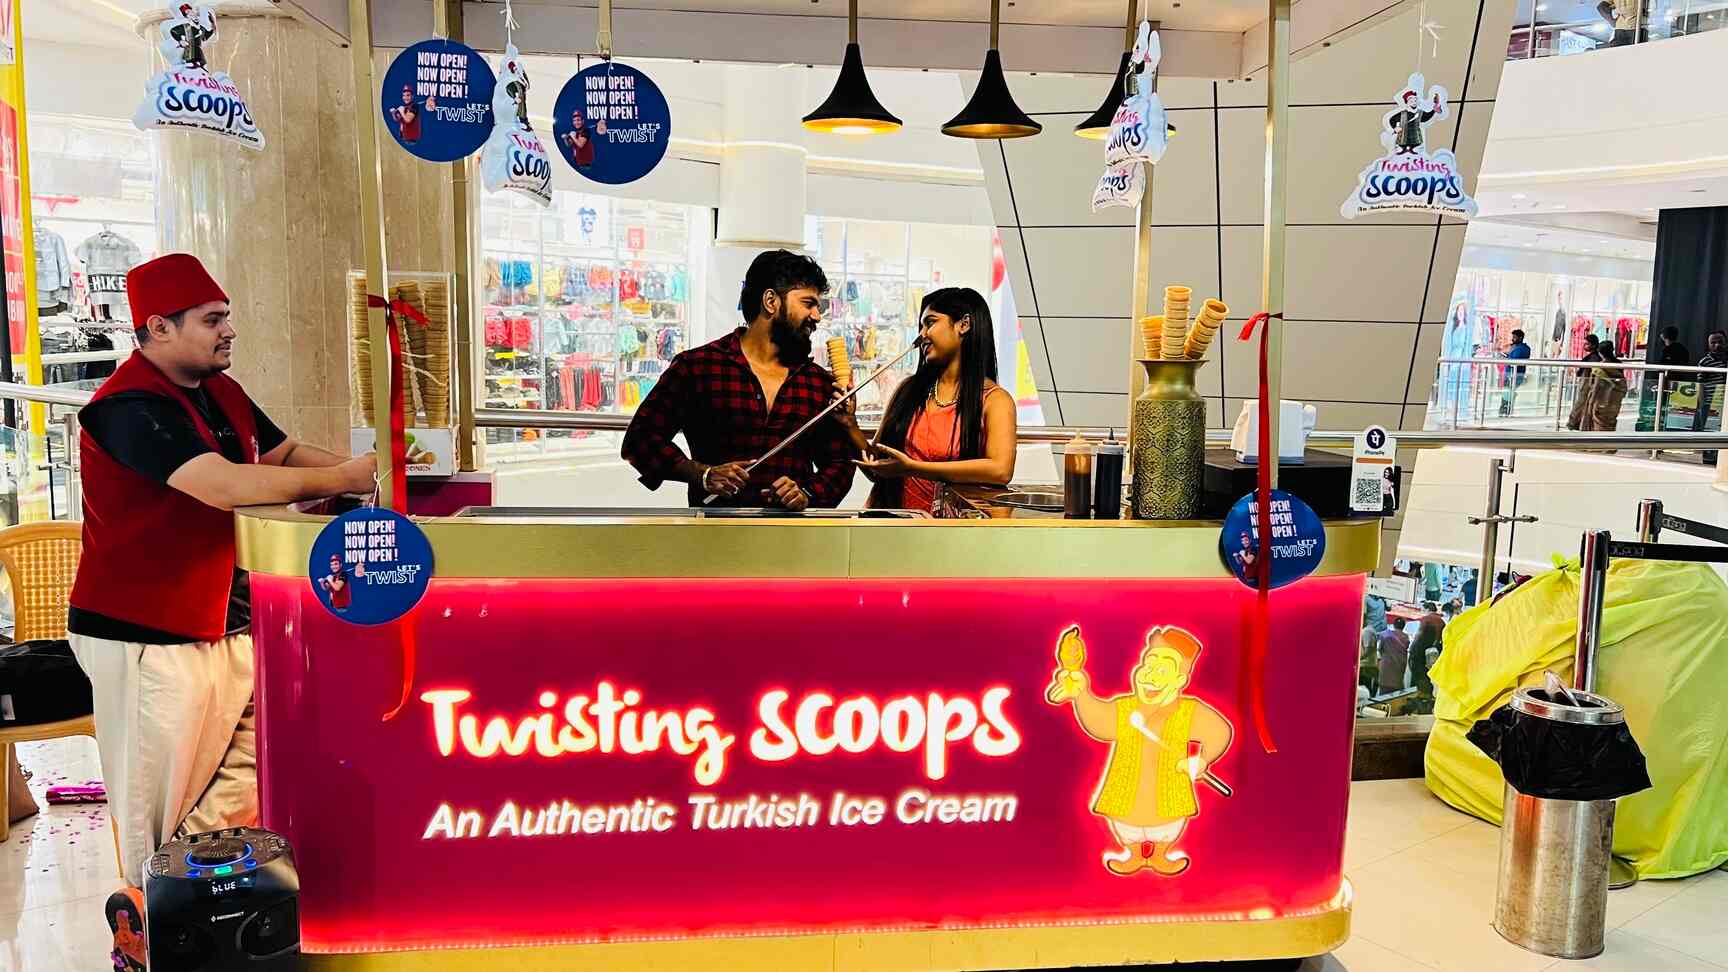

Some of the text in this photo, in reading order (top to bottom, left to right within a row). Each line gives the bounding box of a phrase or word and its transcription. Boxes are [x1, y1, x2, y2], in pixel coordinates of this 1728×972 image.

[417, 52, 468, 68] NOW OPEN!
[416, 66, 467, 83] NOW OPEN!
[416, 82, 438, 97] NOW
[585, 75, 635, 90] NOW OPEN!
[586, 91, 635, 104] NOW OPEN!
[435, 106, 486, 123] TWIST
[586, 106, 607, 120] NOW
[606, 128, 657, 143] TWIST
[1381, 156, 1451, 179] Twisting
[91, 276, 127, 290] HIKE
[1248, 502, 1259, 513] NO
[344, 520, 395, 534] NOW OPEN!
[344, 534, 395, 548] NOW OPEN!
[344, 550, 366, 563] NOW
[1270, 544, 1314, 559] TWIST
[364, 570, 417, 584] TWIST
[420, 681, 735, 785] Twisting
[422, 789, 1018, 840] An Authentic Turkish Ice Cream
